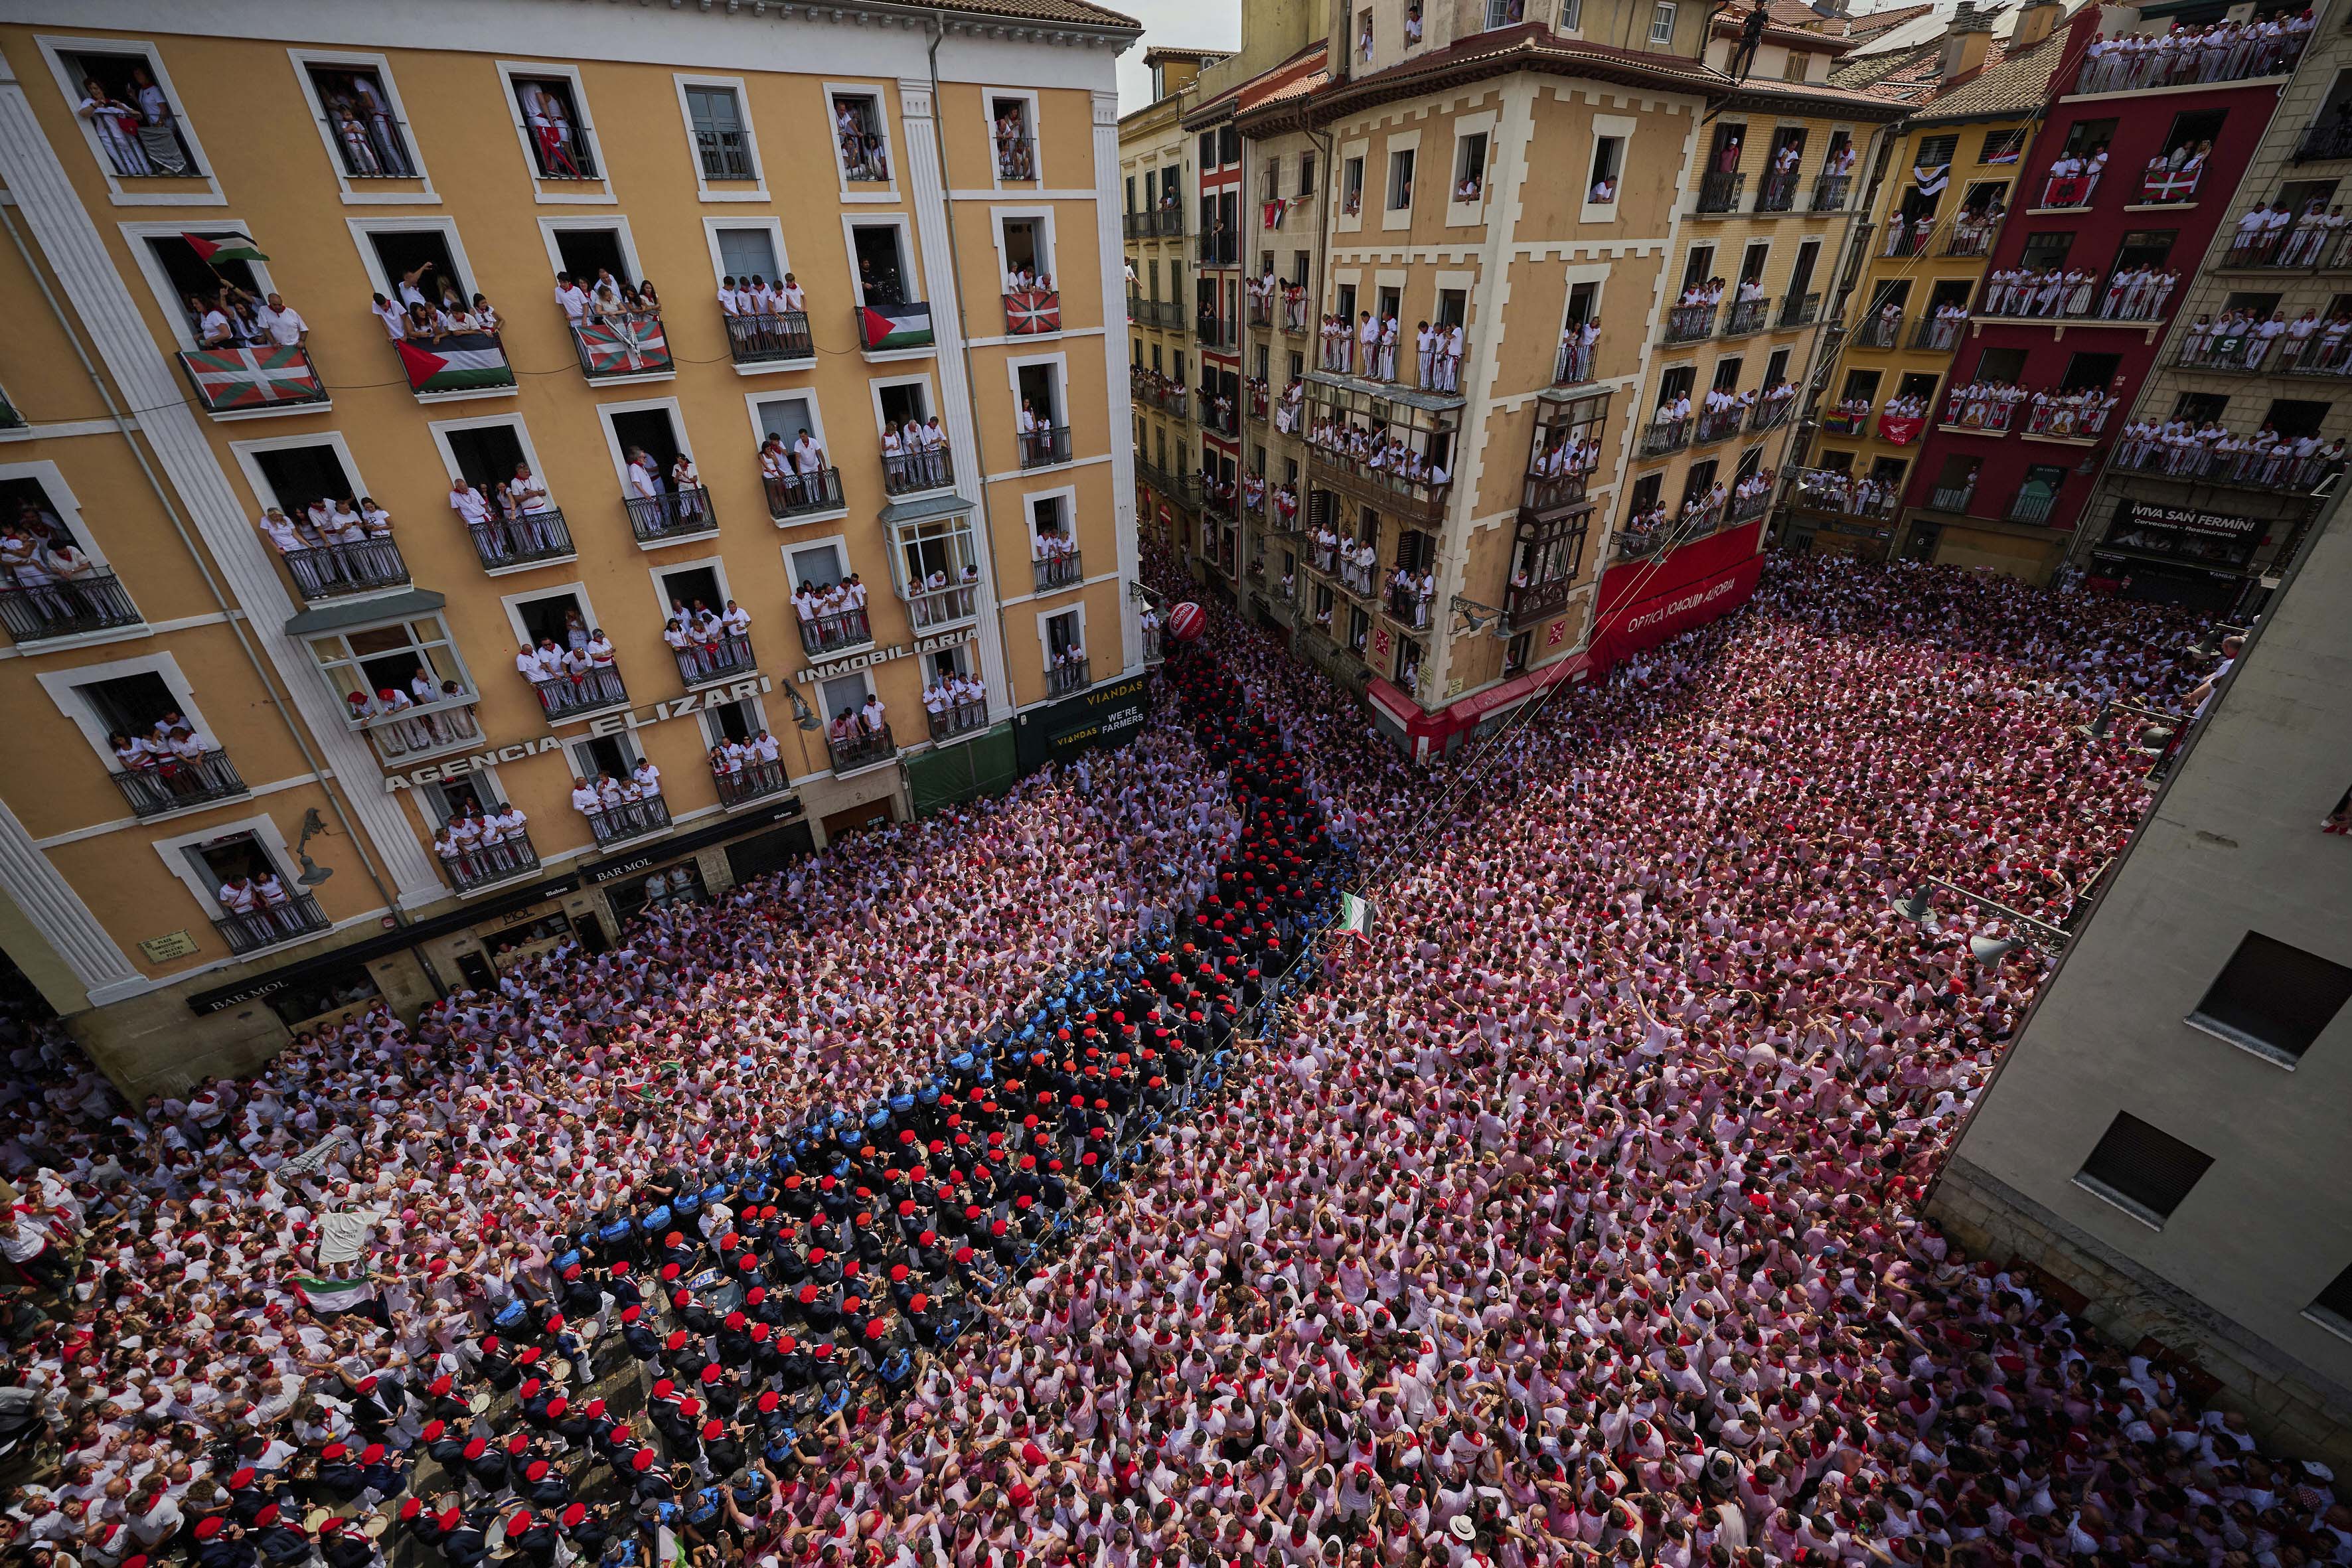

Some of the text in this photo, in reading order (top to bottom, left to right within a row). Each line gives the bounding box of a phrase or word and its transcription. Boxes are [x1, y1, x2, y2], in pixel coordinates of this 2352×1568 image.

[2132, 506, 2255, 531] ¡VIVA SAN FERMÍN!
[2185, 526, 2236, 538] Restaurante
[1172, 605, 1192, 629] Albéniz
[1628, 607, 1664, 633] OPTICA
[1087, 680, 1143, 706] VIANDAS
[386, 629, 980, 793] AGENCIA ELIZARI INMOBILIARIA
[1102, 714, 1144, 734] FARMERS
[1057, 728, 1097, 745] VIANDAS
[774, 811, 791, 820] Mahou
[596, 858, 653, 882] BAR MOL
[546, 887, 568, 896] Mahou
[210, 981, 289, 1010] BAR MOL
